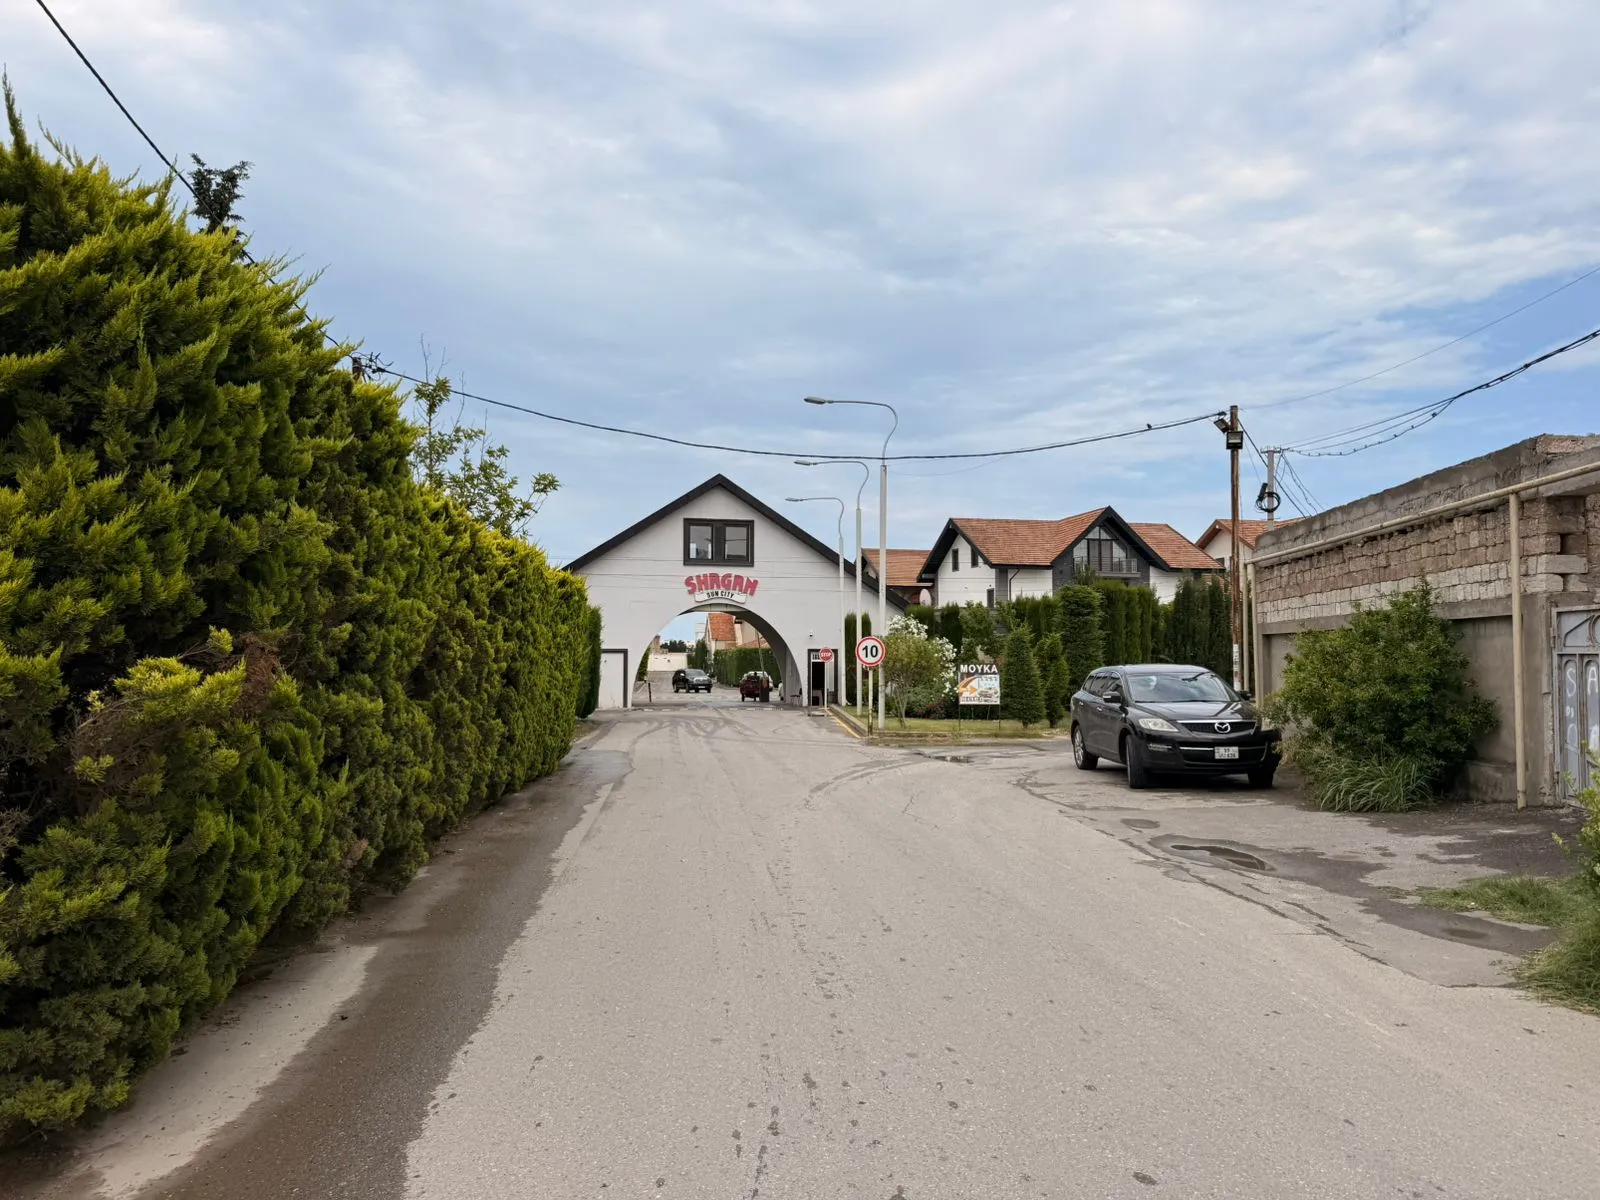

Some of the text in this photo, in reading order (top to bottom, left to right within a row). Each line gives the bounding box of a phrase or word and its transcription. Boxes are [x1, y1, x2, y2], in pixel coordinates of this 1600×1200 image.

[684, 572, 759, 596] SHAGAN
[706, 590, 735, 599] SUN CITY
[862, 644, 878, 658] 10
[960, 664, 998, 673] MOYKA
